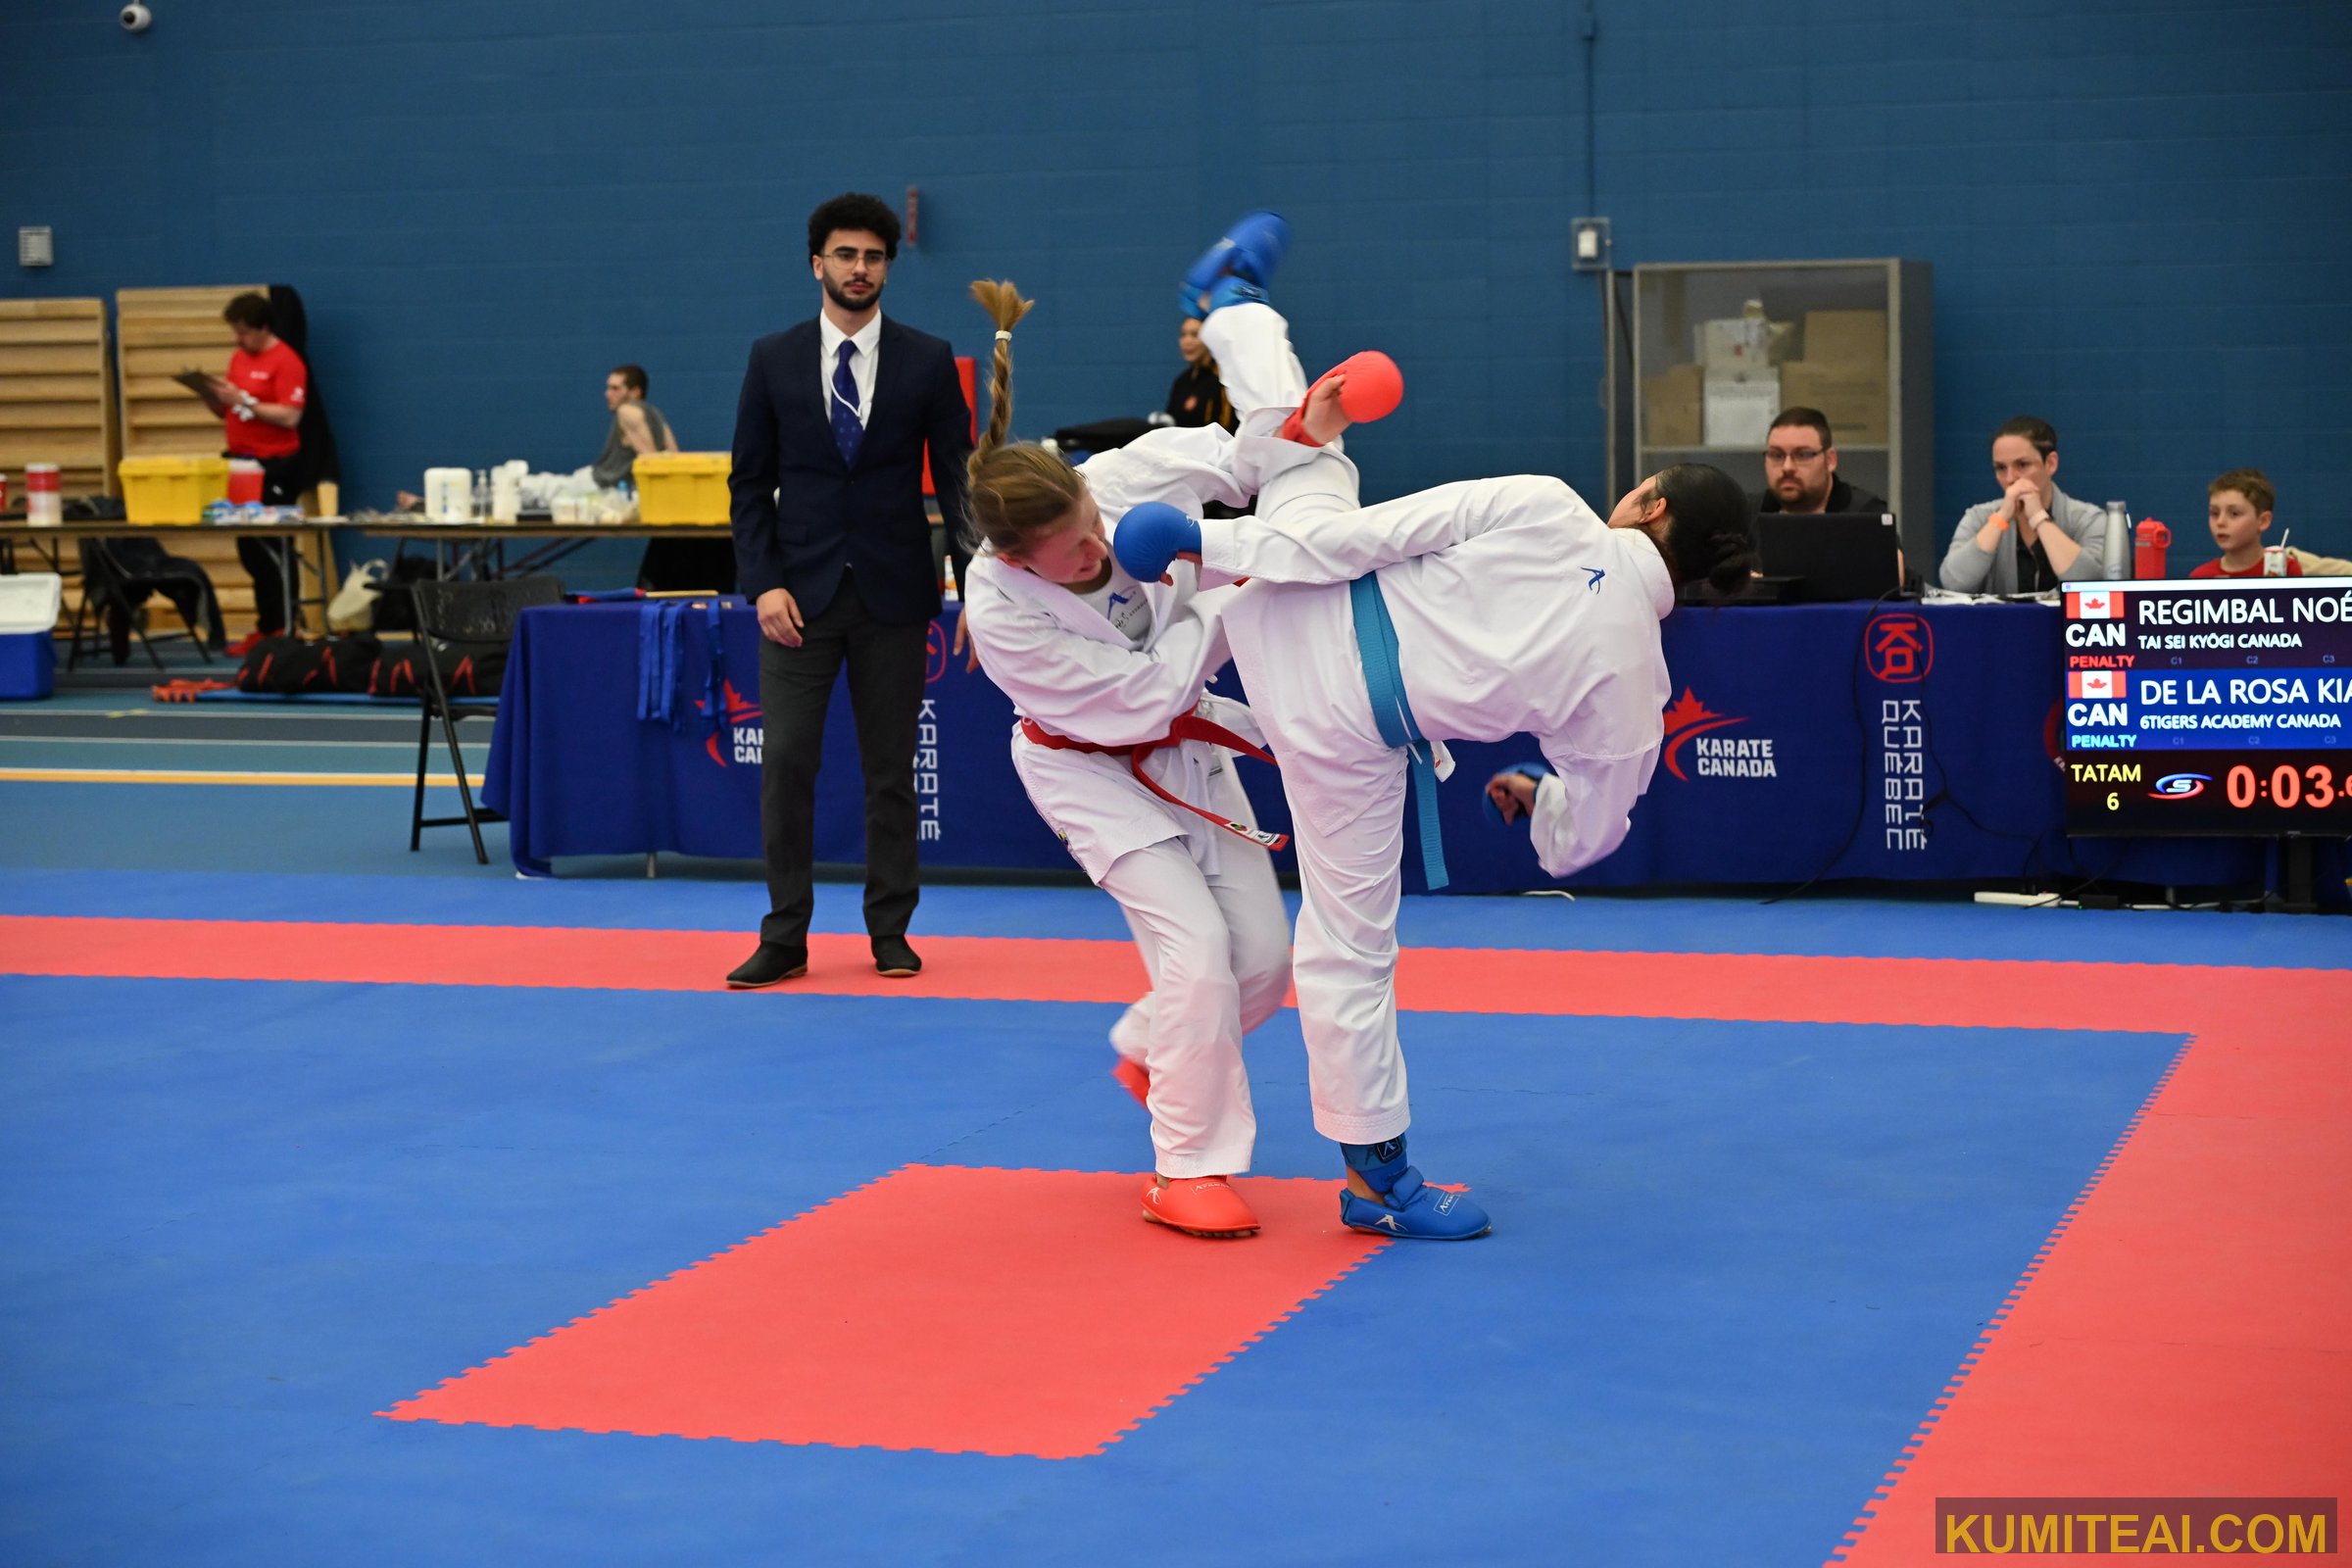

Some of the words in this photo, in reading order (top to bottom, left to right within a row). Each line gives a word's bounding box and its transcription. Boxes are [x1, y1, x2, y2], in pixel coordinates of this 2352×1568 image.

[2139, 599, 2283, 624] REGIMBAL
[2065, 623, 2127, 648] CAN
[2137, 635, 2161, 650] TAI
[2164, 635, 2185, 649] SEI
[2237, 633, 2302, 648] CANADA
[2070, 655, 2134, 668] PENALTY
[2246, 656, 2259, 665] C2
[2140, 680, 2178, 705] DE
[2186, 680, 2222, 704] LA
[2230, 679, 2310, 704] ROSA
[2067, 703, 2128, 727] CAN
[2139, 714, 2197, 730] 6TIGERS
[2201, 713, 2274, 729] ACADEMY
[2277, 713, 2341, 728] CANADA
[1696, 738, 1773, 759] KARATE
[2071, 735, 2137, 748] PENALTY
[918, 699, 941, 841] KARATÉ
[1697, 758, 1777, 777] CANADA
[2071, 763, 2141, 782] TATAM
[2106, 792, 2120, 810] 6
